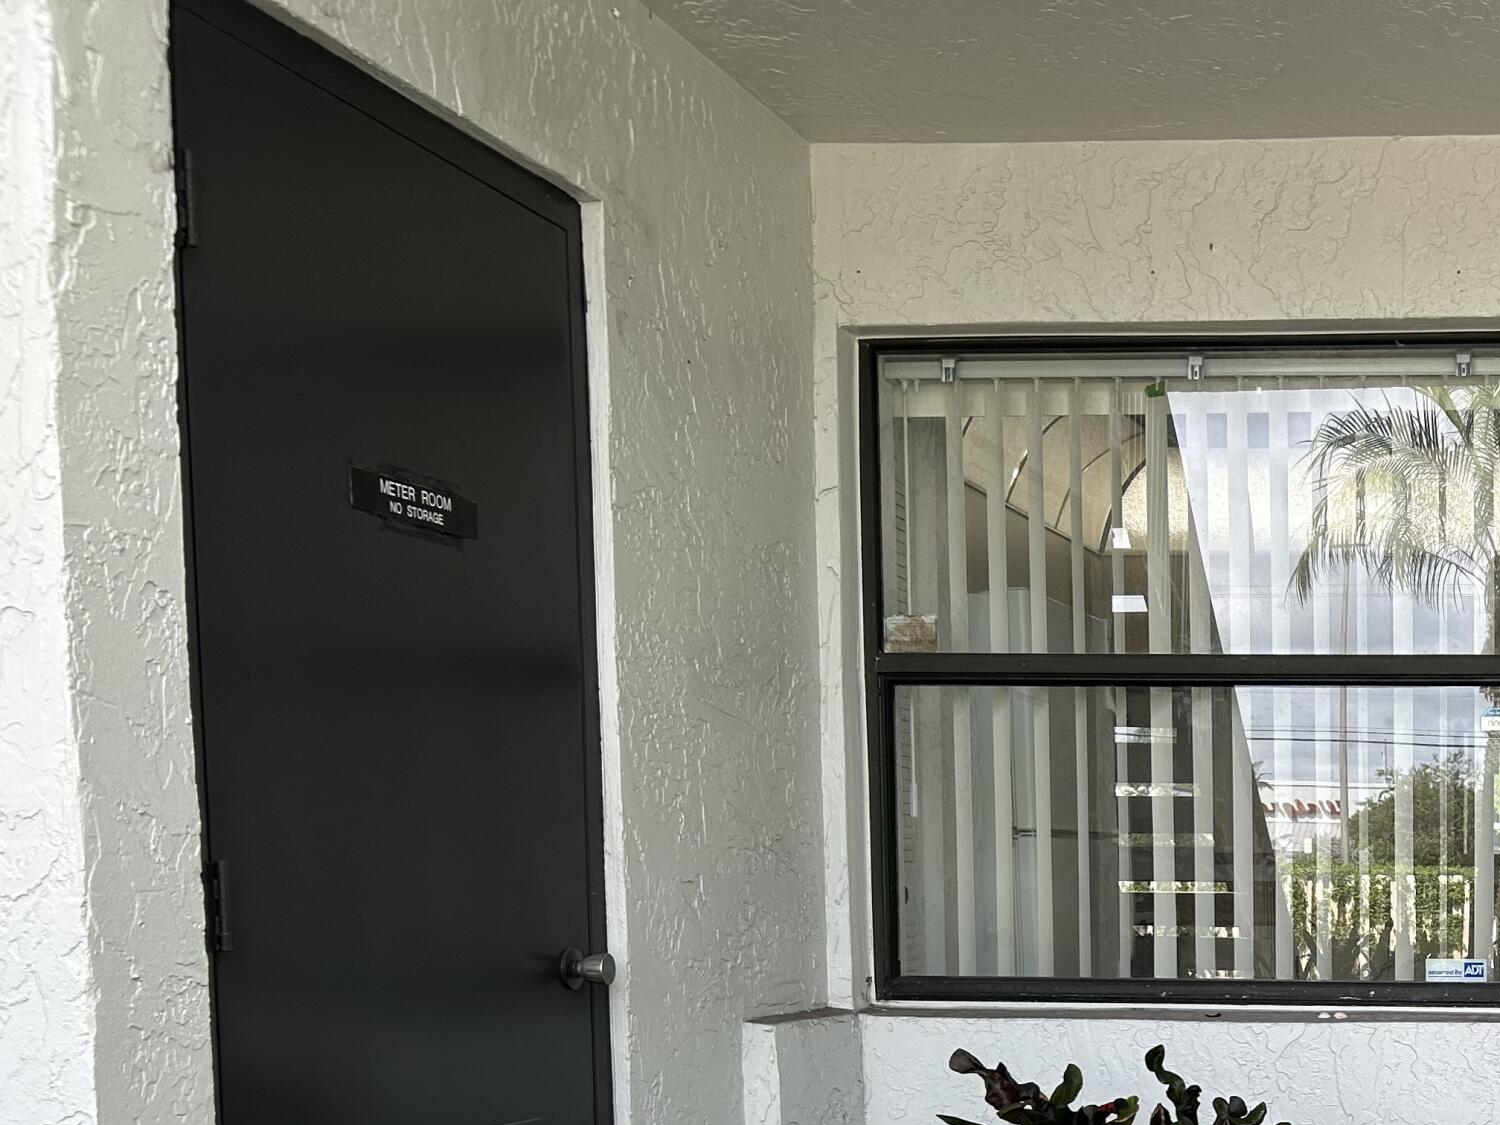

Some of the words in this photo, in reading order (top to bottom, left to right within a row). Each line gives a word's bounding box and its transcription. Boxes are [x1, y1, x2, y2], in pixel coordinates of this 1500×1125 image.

[380, 478, 416, 502] METER
[421, 490, 452, 512] ROOM
[389, 500, 403, 514] NO
[406, 505, 444, 525] STORAGE
[1454, 967, 1462, 976] by
[1465, 964, 1484, 976] ADT
